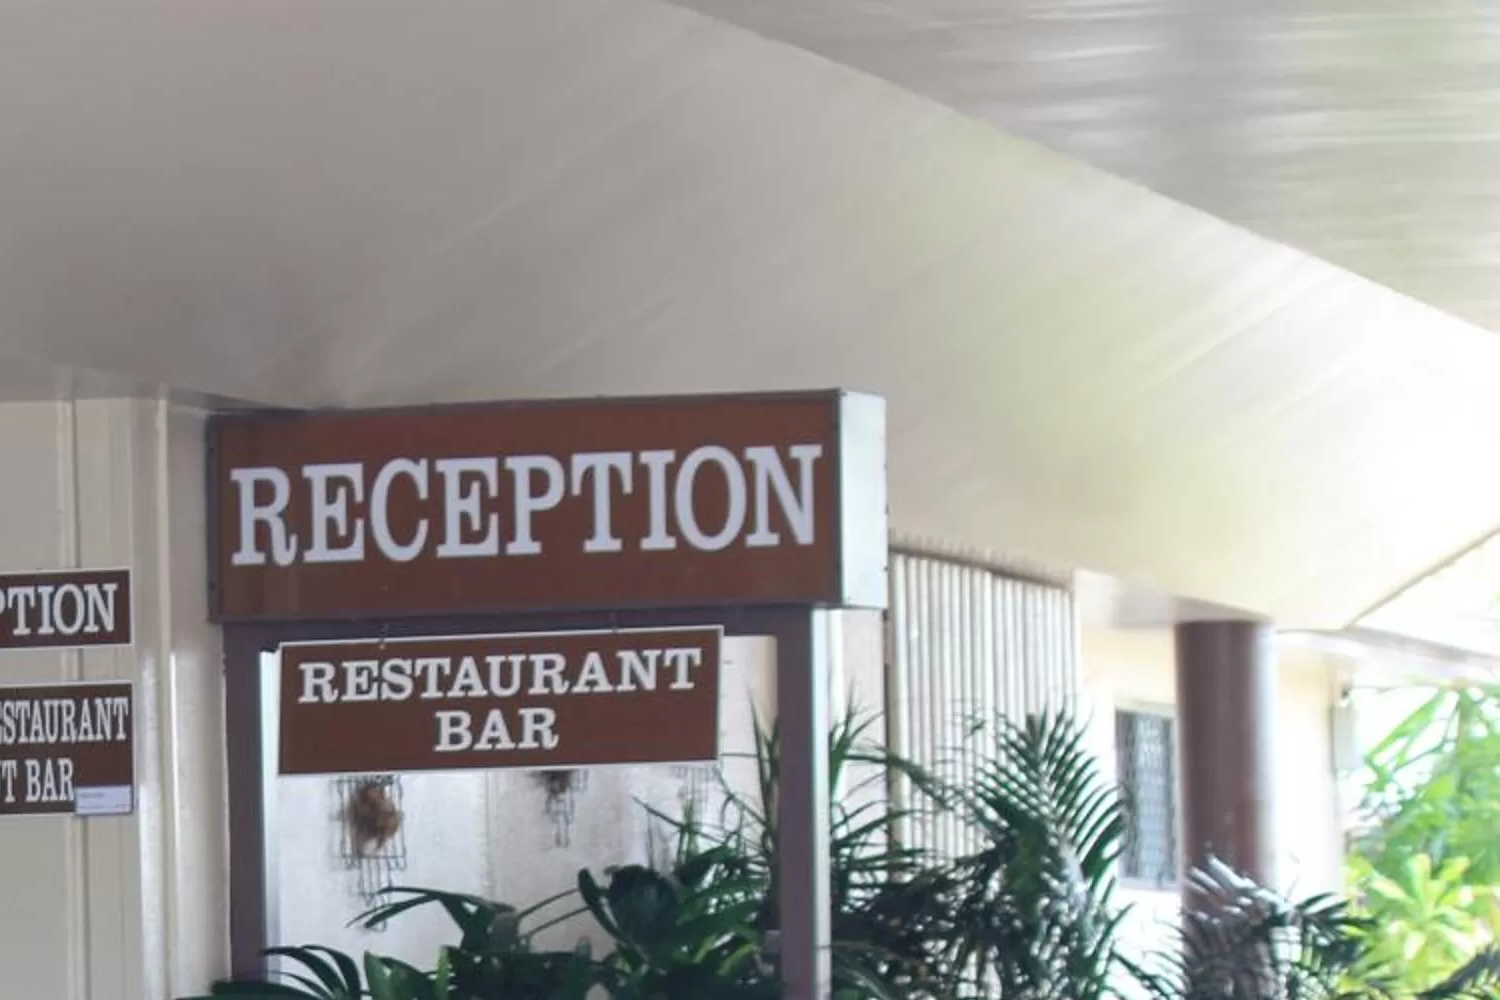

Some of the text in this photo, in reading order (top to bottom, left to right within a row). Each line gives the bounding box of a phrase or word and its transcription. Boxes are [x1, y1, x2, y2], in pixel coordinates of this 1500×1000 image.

[231, 445, 822, 565] RECEPTION
[297, 647, 702, 704] RESTAURANT
[435, 708, 559, 752] BAR
[25, 757, 75, 802] BAR
